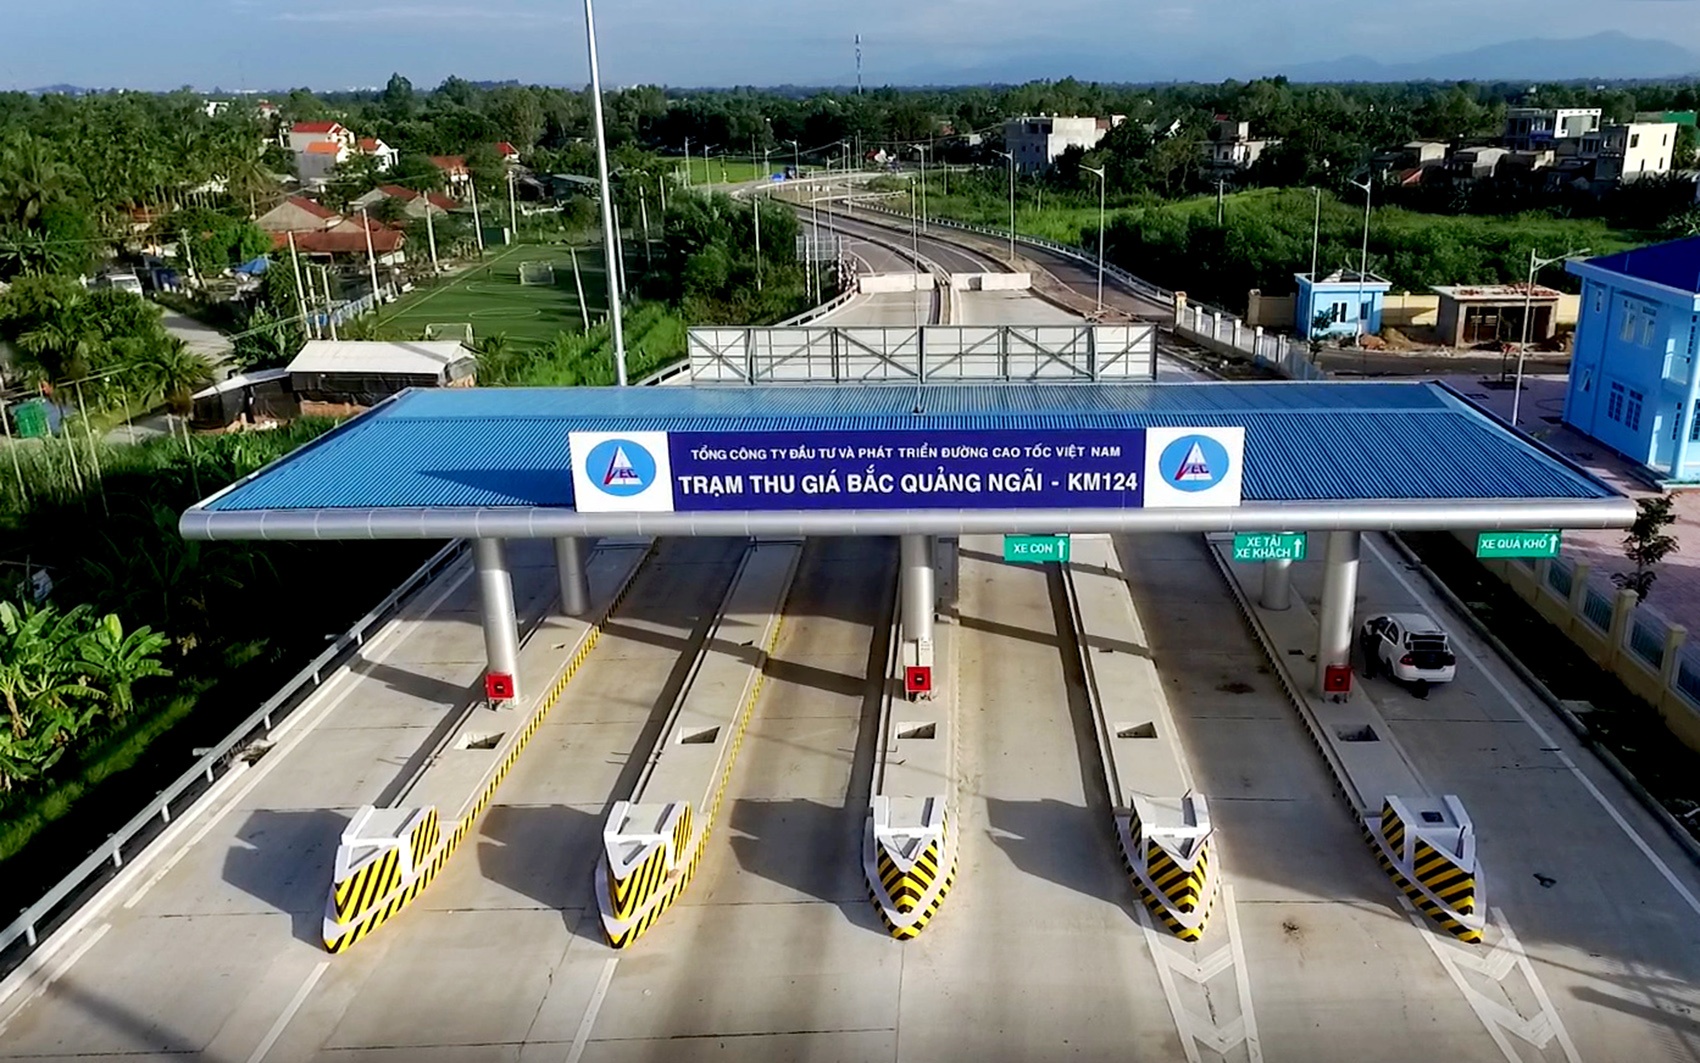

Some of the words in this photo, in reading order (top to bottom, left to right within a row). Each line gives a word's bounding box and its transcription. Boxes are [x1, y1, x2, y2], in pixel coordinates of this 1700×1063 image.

[690, 444, 727, 461] TỔNG
[729, 446, 767, 461] CÔNG
[770, 449, 787, 460] TY
[818, 447, 836, 459] TƯ
[838, 445, 856, 459] VÀ
[858, 445, 893, 459] PHÁT
[898, 442, 938, 459] TRIỂN
[941, 444, 988, 459] ĐƯỜNG
[992, 447, 1021, 458] CAO
[1024, 442, 1052, 458] TỐC
[1056, 443, 1085, 459] VIỆT
[1091, 446, 1121, 458] NAM
[678, 475, 744, 497] TRẠM
[749, 474, 796, 494] THU
[801, 468, 841, 494] GIÁ
[847, 463, 895, 494] BẮC
[900, 465, 982, 494] QUẢNG
[988, 467, 1043, 492] NGÃI
[1067, 472, 1138, 492] KM124
[1013, 543, 1028, 554] XE
[1029, 543, 1054, 554] CON
[1246, 536, 1262, 548] XE
[1480, 539, 1496, 549] XE
[1497, 535, 1521, 549] QUÁ
[1234, 547, 1252, 559] XE
[1252, 546, 1291, 559] KHÁCH
